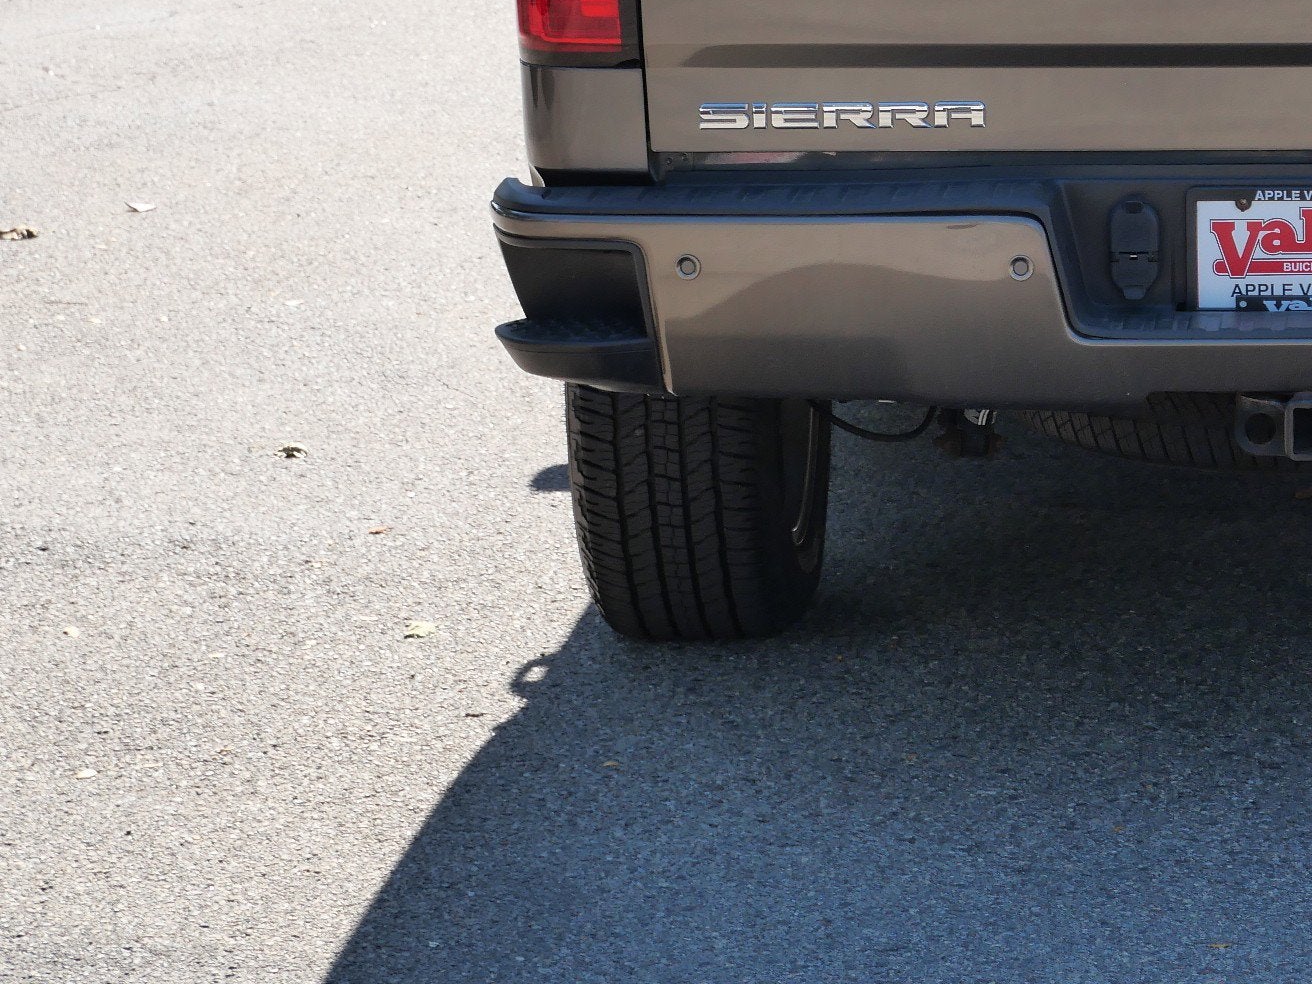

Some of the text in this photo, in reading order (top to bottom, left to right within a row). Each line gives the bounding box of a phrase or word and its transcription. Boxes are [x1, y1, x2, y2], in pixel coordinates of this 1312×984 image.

[699, 101, 986, 130] SIERRA
[1254, 190, 1301, 201] APPLE
[1231, 283, 1294, 297] APPLE
